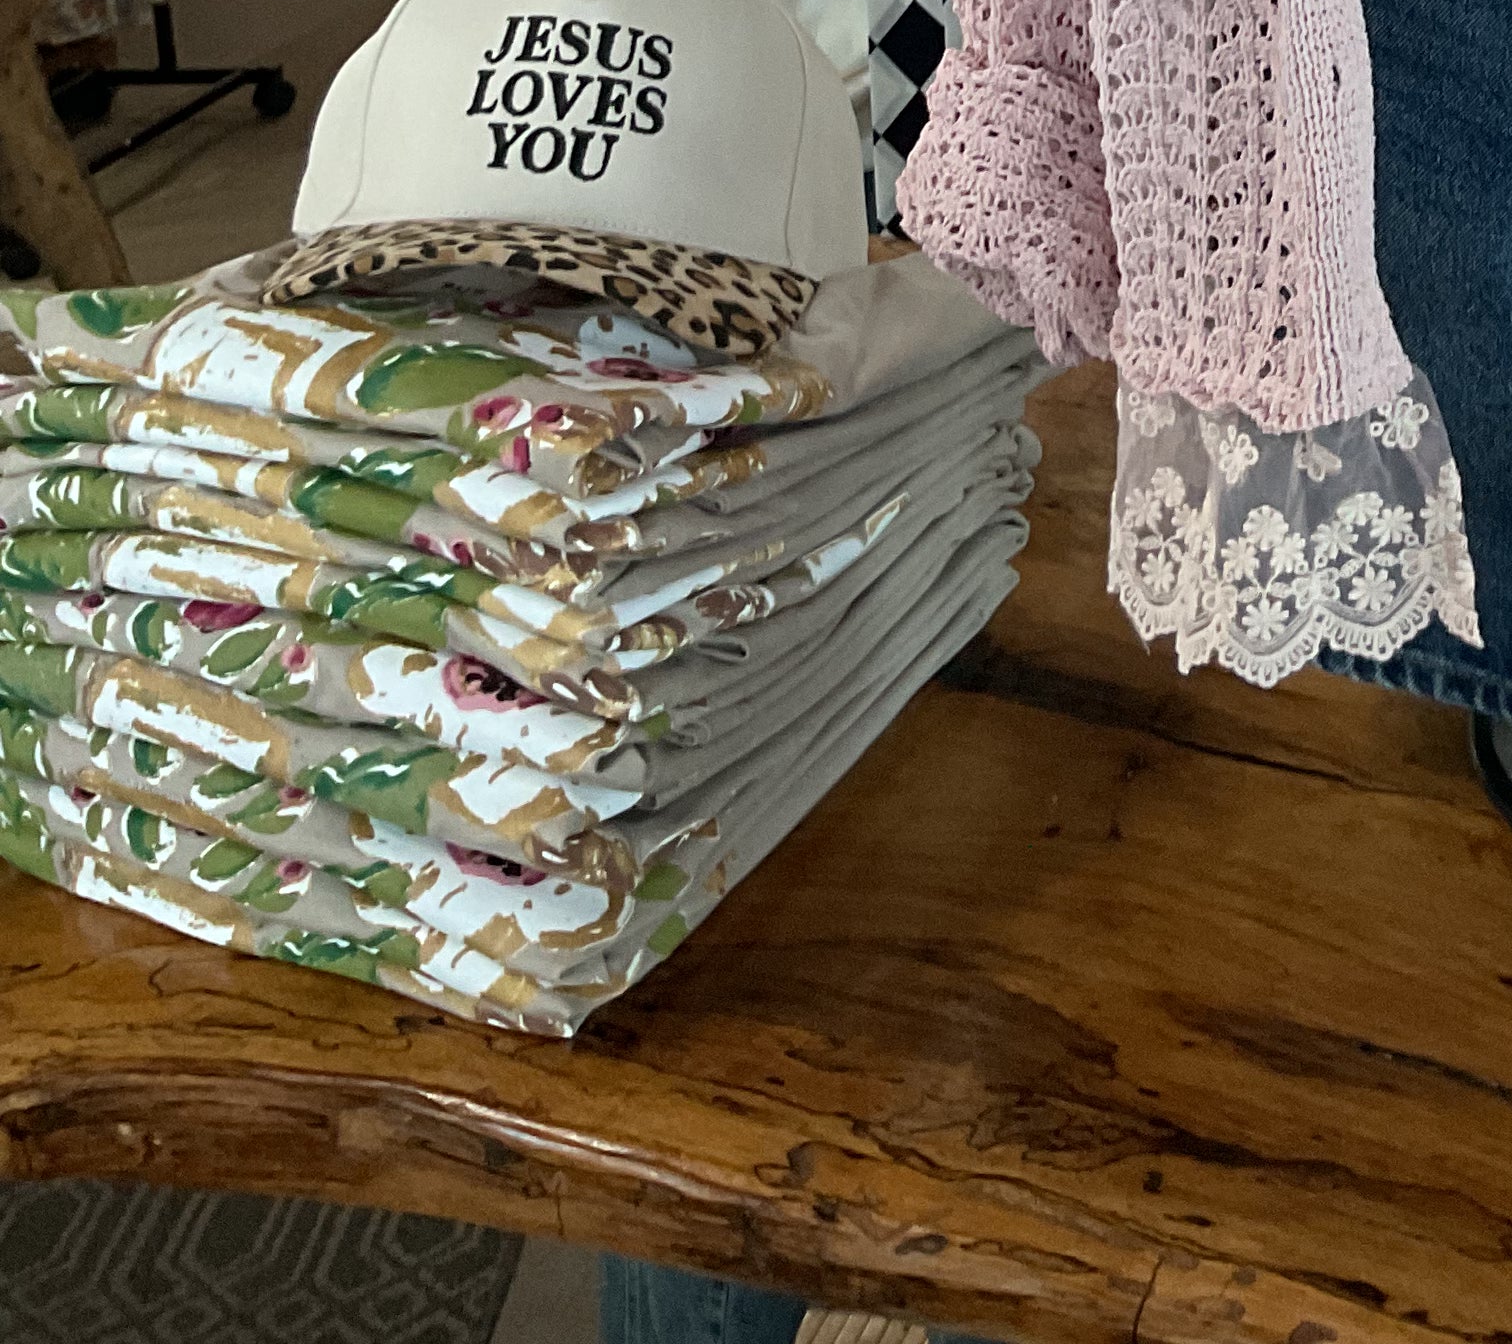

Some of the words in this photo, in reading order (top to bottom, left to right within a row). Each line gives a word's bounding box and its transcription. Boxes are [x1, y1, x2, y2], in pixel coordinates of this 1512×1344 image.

[484, 15, 673, 80] JESUS
[465, 69, 668, 135] LOVES
[486, 122, 620, 183] YOU
